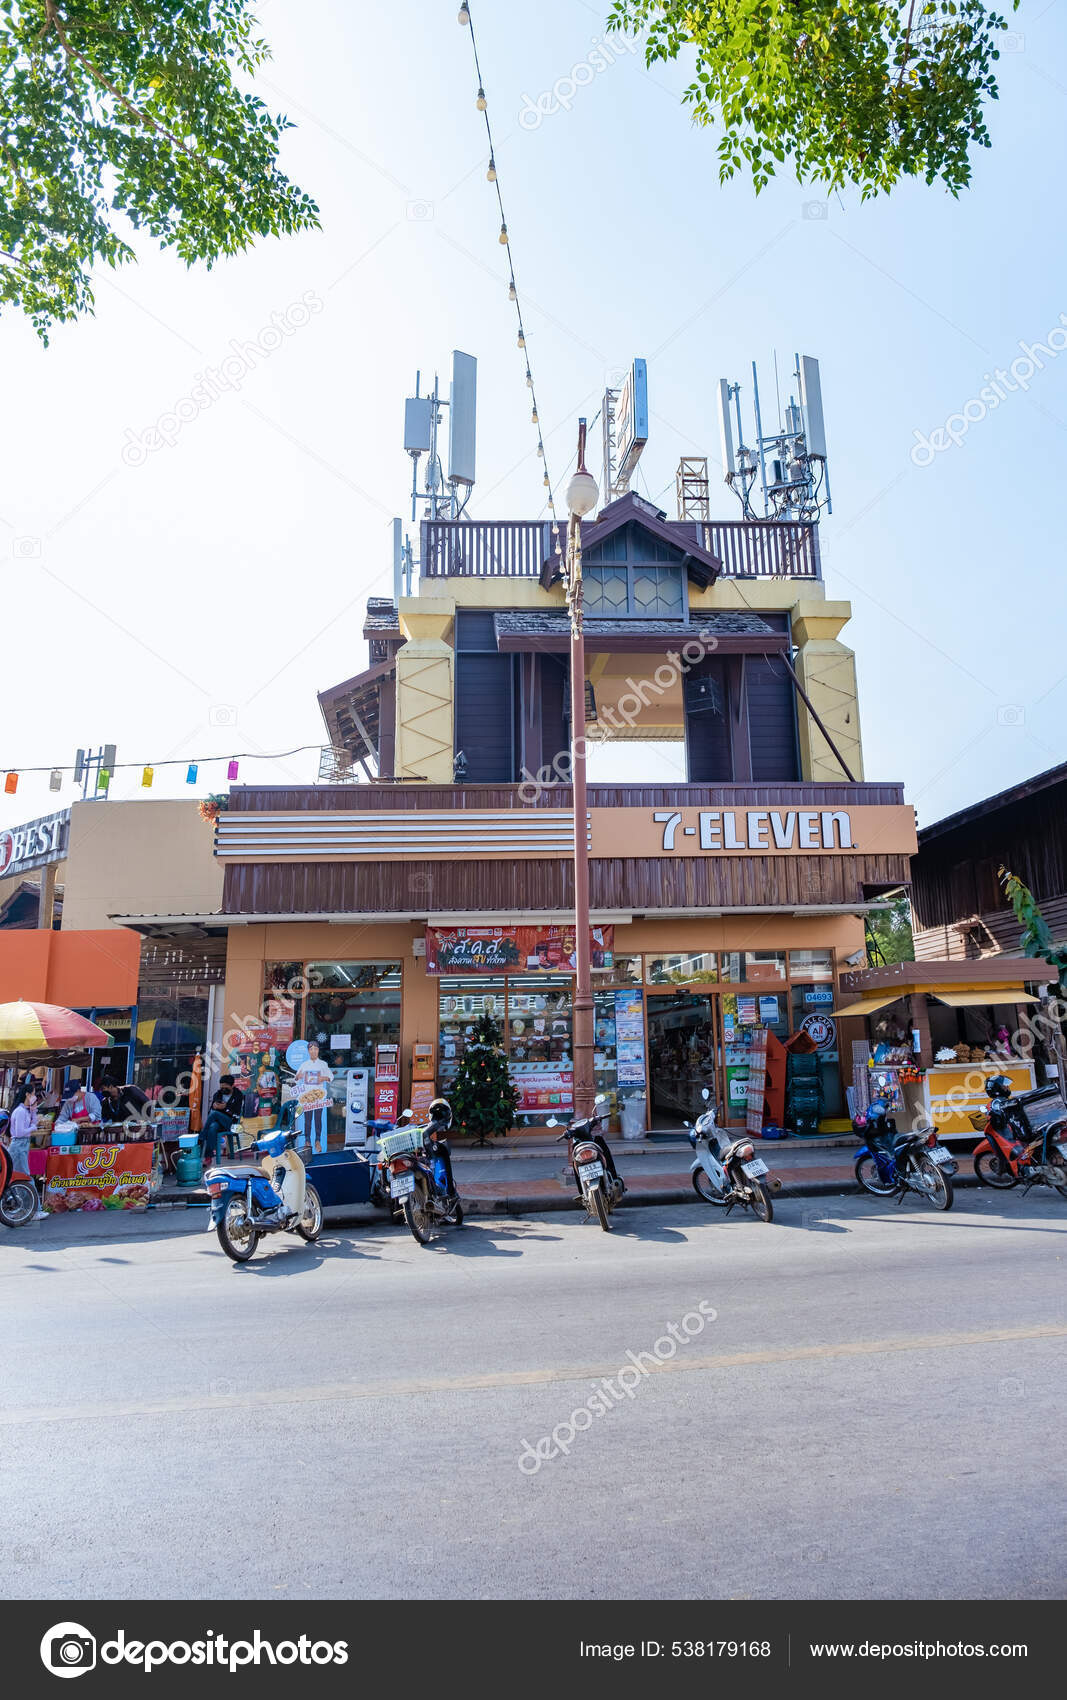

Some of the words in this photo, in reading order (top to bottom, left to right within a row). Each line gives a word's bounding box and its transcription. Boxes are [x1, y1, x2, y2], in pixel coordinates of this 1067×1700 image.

[12, 818, 63, 863] BEST
[378, 1094, 394, 1102] 5G
[84, 1147, 121, 1169] JJ
